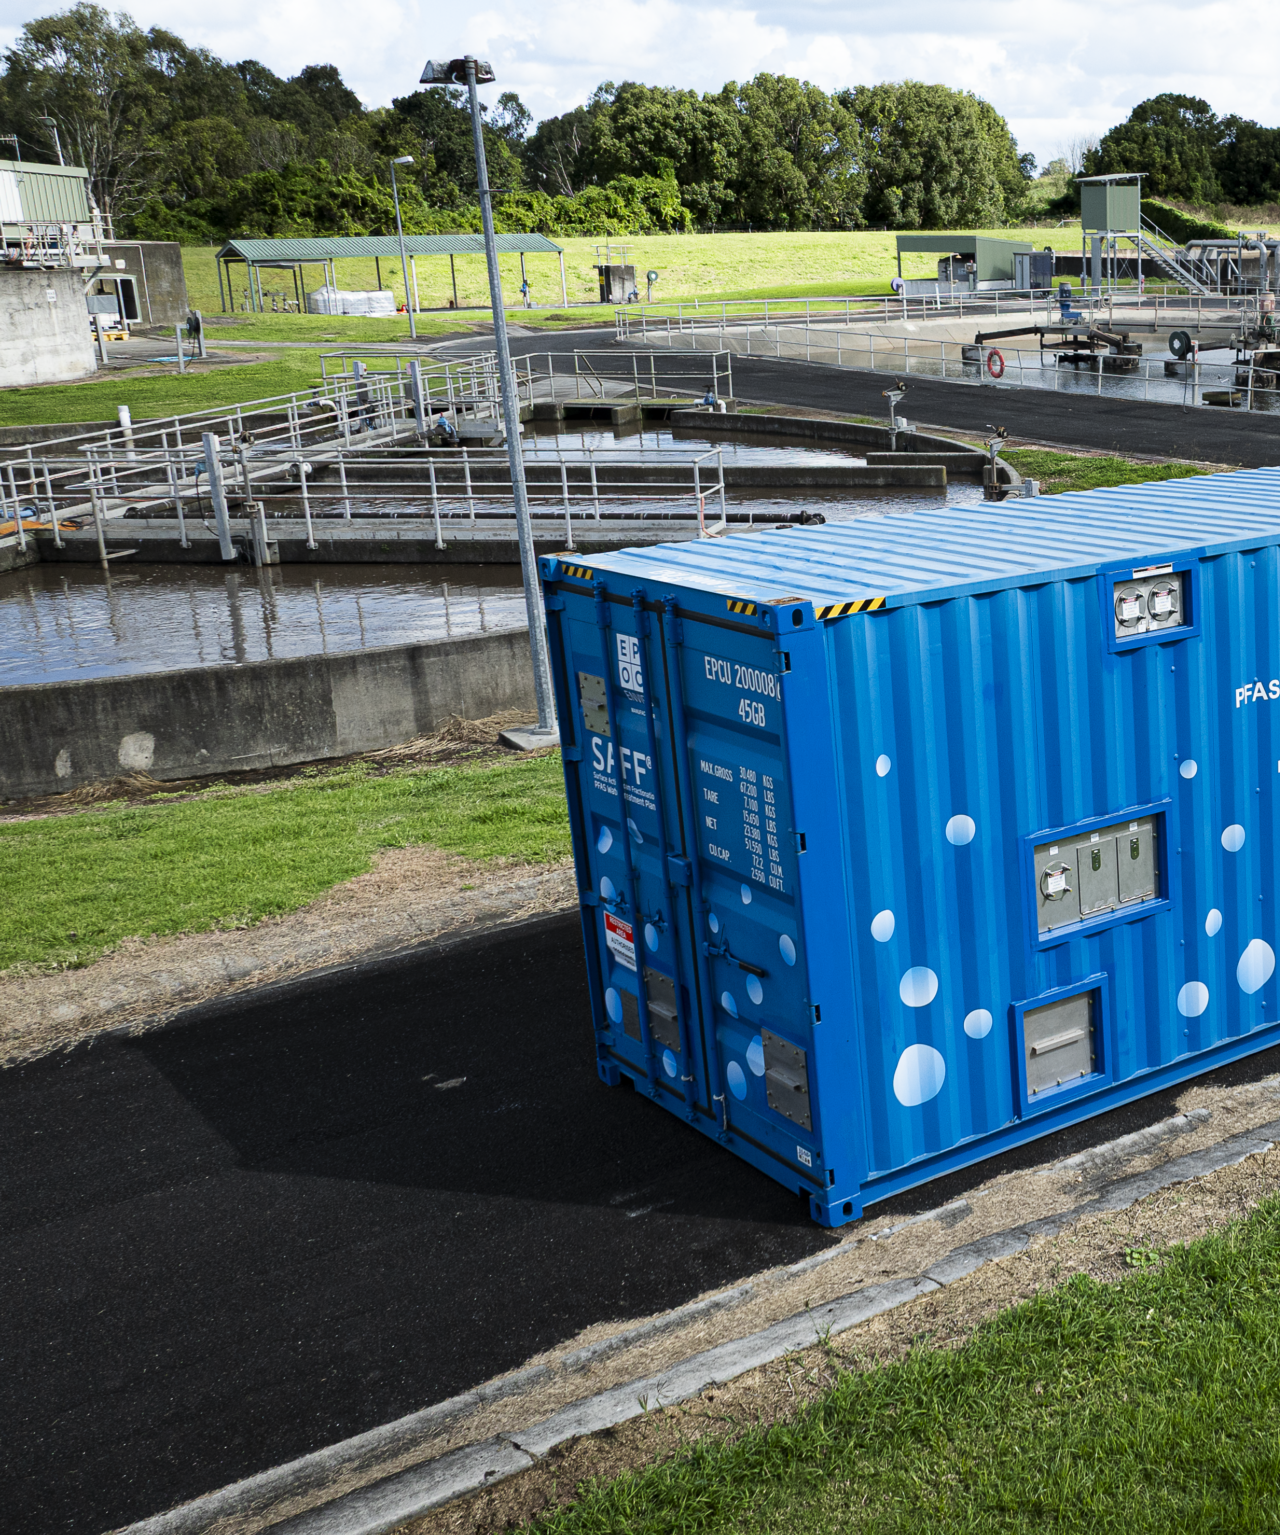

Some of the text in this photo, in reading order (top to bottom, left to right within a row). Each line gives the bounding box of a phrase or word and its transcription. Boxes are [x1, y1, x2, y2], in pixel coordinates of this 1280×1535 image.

[704, 655, 732, 685] EPCU
[1235, 681, 1280, 709] PFAS
[738, 697, 766, 728] 45GB
[762, 774, 774, 790] KGS
[632, 785, 656, 801] Fractionatio
[763, 789, 775, 804] LBS
[645, 799, 657, 812] Plan
[764, 803, 776, 819] KGS
[705, 815, 718, 831] NET
[766, 833, 779, 848] KGS
[765, 818, 777, 834] LBS
[768, 847, 780, 863] LBS
